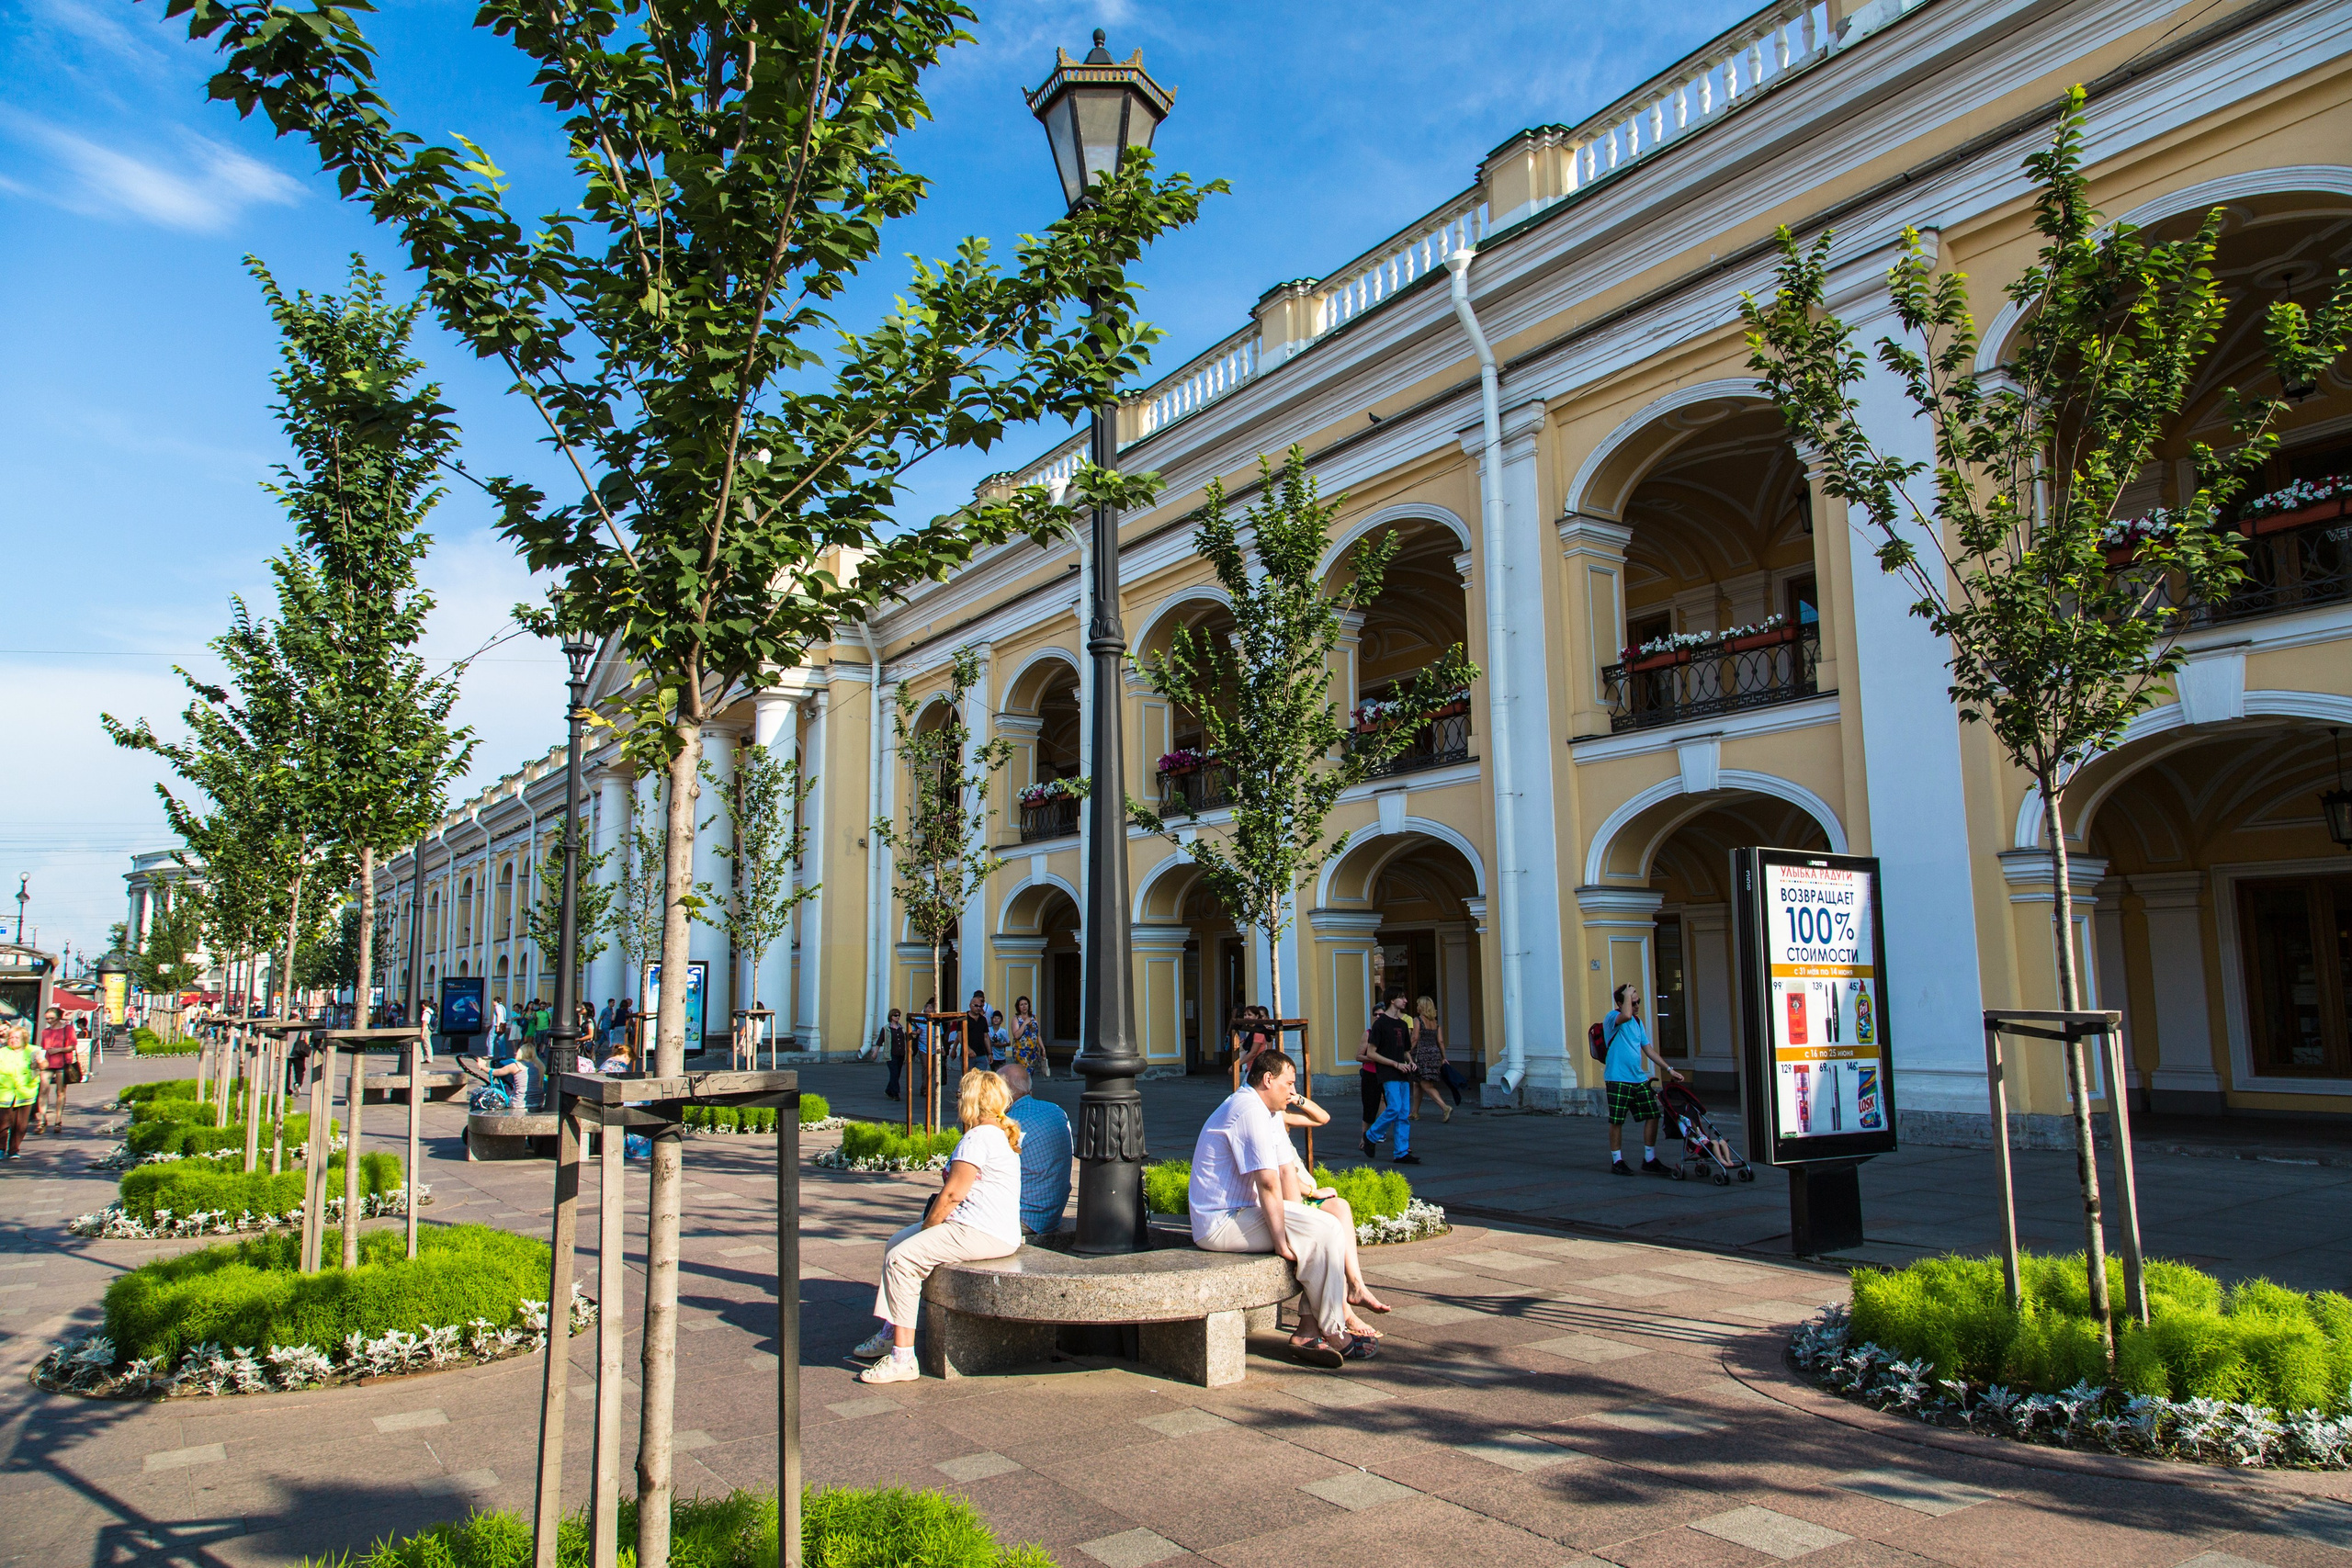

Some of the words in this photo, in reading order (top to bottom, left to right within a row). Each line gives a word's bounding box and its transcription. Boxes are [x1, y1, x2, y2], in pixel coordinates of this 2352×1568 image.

[1780, 865, 1817, 879] УЛЫБКА
[1819, 868, 1853, 882] РАДУГИ
[1781, 887, 1854, 906] ВОЗВРАЩАЕТ
[1785, 907, 1855, 945] 100%
[1787, 947, 1859, 963] СТОИМОСТИ
[1799, 967, 1805, 976] 31
[1830, 967, 1838, 976] 14
